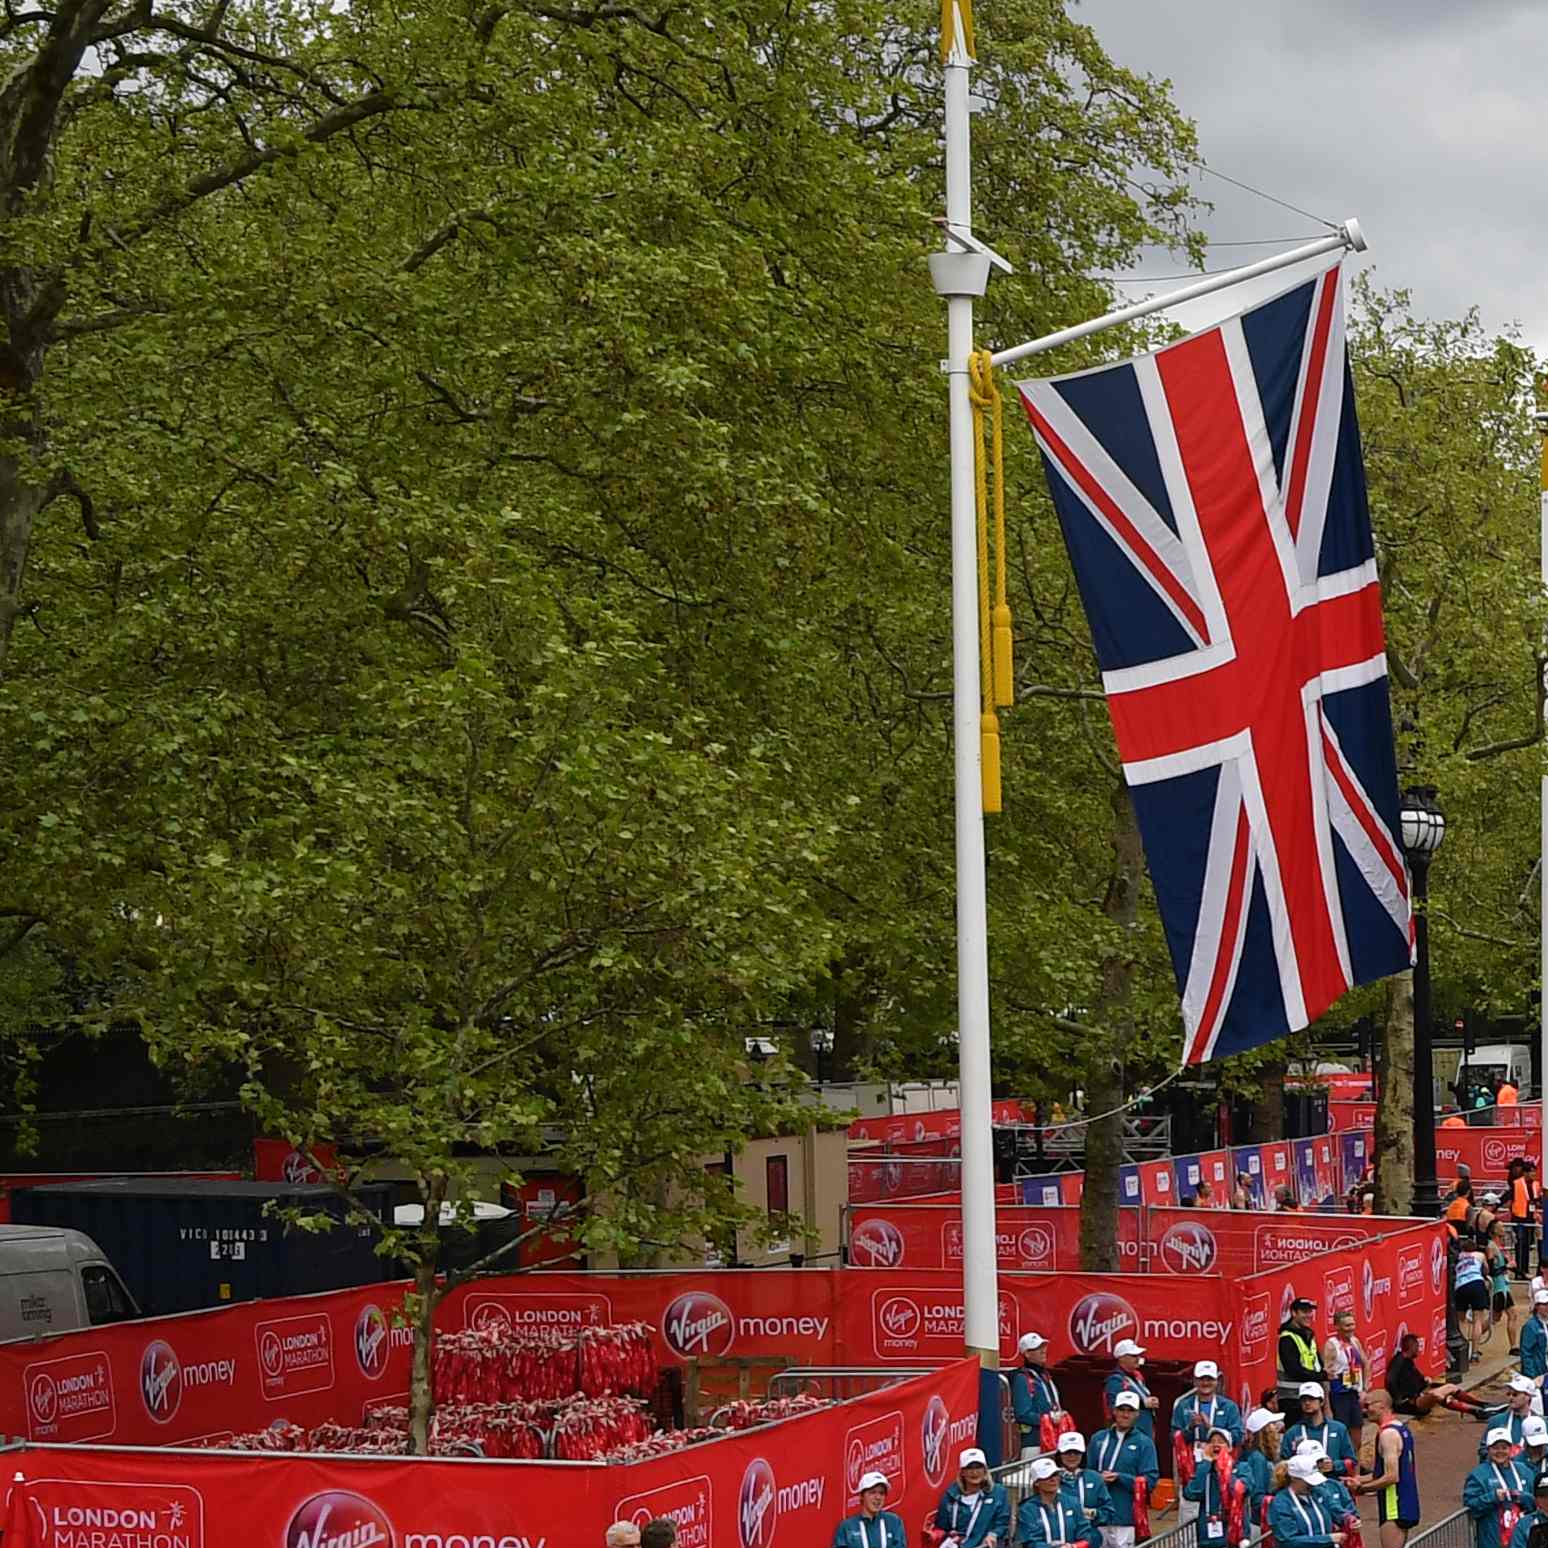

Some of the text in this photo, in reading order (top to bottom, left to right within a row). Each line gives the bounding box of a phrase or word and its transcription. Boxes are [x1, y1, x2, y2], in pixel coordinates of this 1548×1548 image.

[515, 1310, 582, 1324] LONDON
[670, 1300, 829, 1353] Virgin money
[1076, 1300, 1133, 1352] Virgin
[1145, 1319, 1232, 1344] money
[282, 1333, 319, 1351] LONDON
[391, 1327, 418, 1348] mon
[284, 1345, 329, 1369] MARATHON
[58, 1374, 95, 1395] LONDON
[144, 1351, 236, 1411] Virgin money
[60, 1390, 109, 1414] MARATHON
[951, 1412, 981, 1446] money
[54, 1506, 156, 1531] LONDON
[742, 1473, 825, 1546] Virgin money
